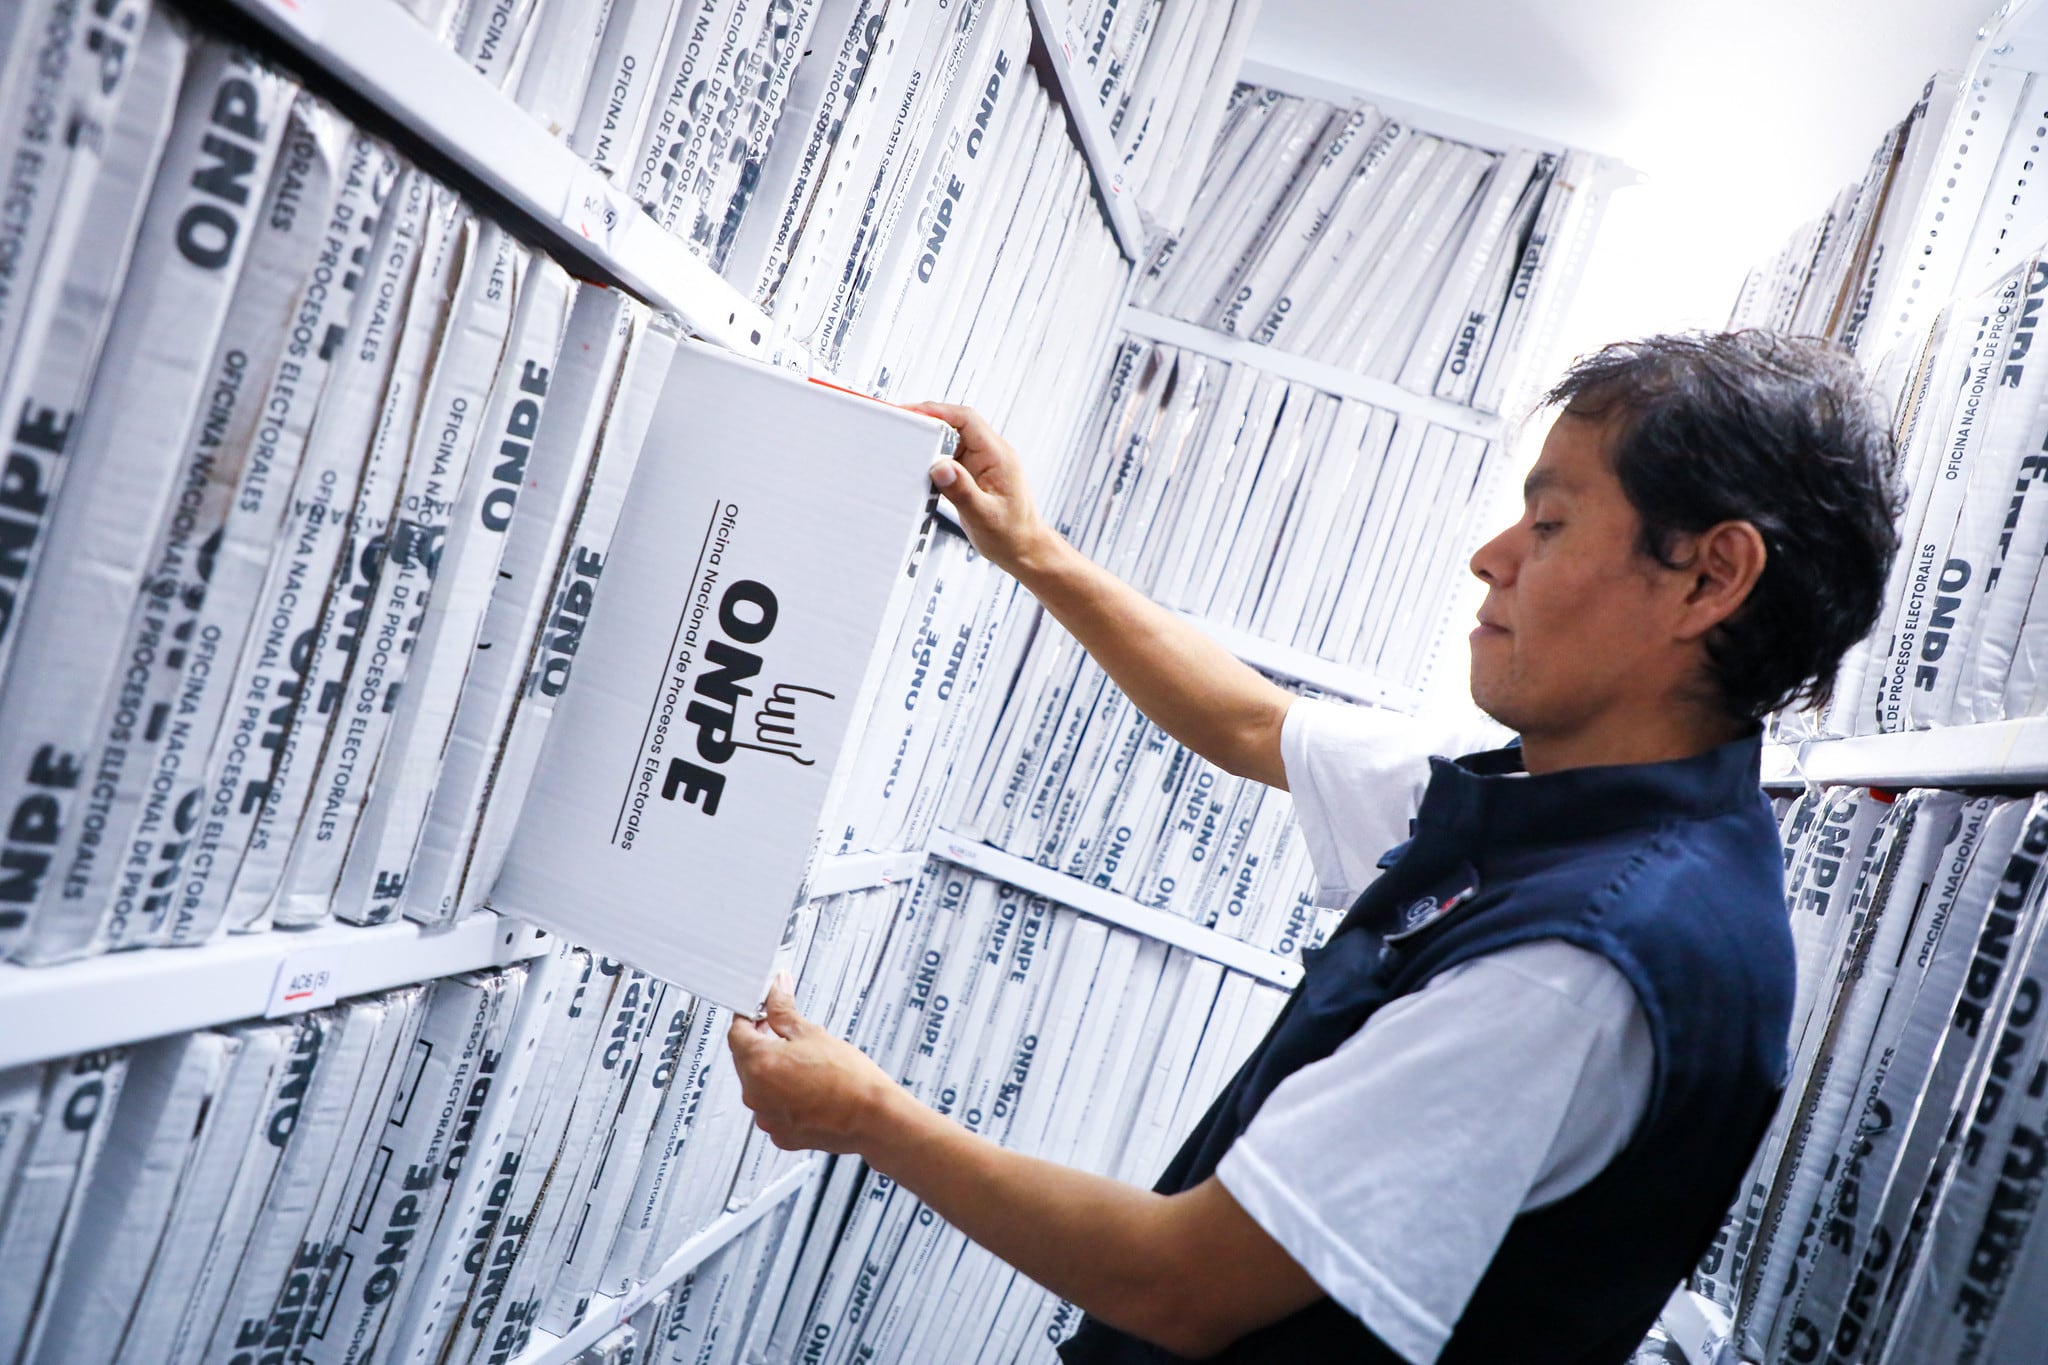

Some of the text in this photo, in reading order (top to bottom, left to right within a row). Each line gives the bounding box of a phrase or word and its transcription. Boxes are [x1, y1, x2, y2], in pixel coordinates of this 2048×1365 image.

[603, 55, 636, 131] OFICINA
[669, 14, 711, 108] NACIONAL
[707, 78, 723, 102] DE
[771, 8, 810, 90] NACIONAL
[657, 109, 677, 136] DE
[676, 102, 715, 193] PROCESOS
[764, 90, 781, 113] DE
[966, 48, 1012, 160] ONPE
[326, 202, 354, 231] DE
[916, 173, 966, 285] ONPE
[288, 235, 343, 358] PROCESOS
[2000, 262, 2048, 389] ONPE
[200, 350, 248, 448] OFICINA
[240, 360, 303, 513] ELECTORALES
[430, 397, 467, 476] OFICINA
[480, 359, 549, 533] ONPE
[1945, 427, 1971, 480] OFICINA
[1961, 360, 1991, 427] NACIONAL
[1982, 338, 1998, 358] DE
[257, 560, 308, 669] NACIONAL
[388, 585, 411, 611] DE
[540, 546, 605, 698] ONPE
[1886, 544, 1936, 721] ELECTORALES PROCESOS DE
[1914, 558, 1972, 693] ONPE
[109, 615, 166, 742] PROCESOS
[178, 624, 222, 715] OFICINA
[247, 674, 271, 702] DE
[357, 612, 401, 715] PROCESOS
[620, 503, 739, 850] Oficina Nacional de Procesos Electorales
[661, 579, 779, 817] ONPE
[905, 630, 940, 711] ONPE
[937, 623, 972, 701] ONPE
[138, 719, 192, 834] NACIONAL
[210, 705, 261, 817] PROCESOS
[315, 716, 368, 842] ELECTORALES
[1178, 771, 1215, 835] ONPE
[62, 745, 127, 900] ELECTORALES
[128, 840, 153, 867] DE
[1192, 801, 1224, 863] ONPE
[1804, 802, 1858, 917] ONPE
[1228, 852, 1260, 917] ONPE
[1279, 891, 1315, 955] ONPE
[1917, 902, 1951, 969] OFICINA
[1943, 819, 1987, 900] NACIONAL
[908, 950, 941, 1012] ONPE
[984, 902, 1017, 966] ONPE
[1010, 920, 1040, 985] ONPE
[602, 970, 645, 1071] ONP
[685, 1041, 709, 1092] NACIONAL
[917, 994, 950, 1058] ONPE
[425, 1061, 470, 1165] ELECTORALES
[442, 1048, 502, 1181] ONPE
[664, 1106, 687, 1160] PROCESOS
[363, 1163, 431, 1306] ONPE
[464, 1151, 522, 1275] ONPE
[641, 1159, 667, 1230] ELECTORALES
[471, 1214, 524, 1330] ONPE
[848, 1260, 880, 1325] ONPE
